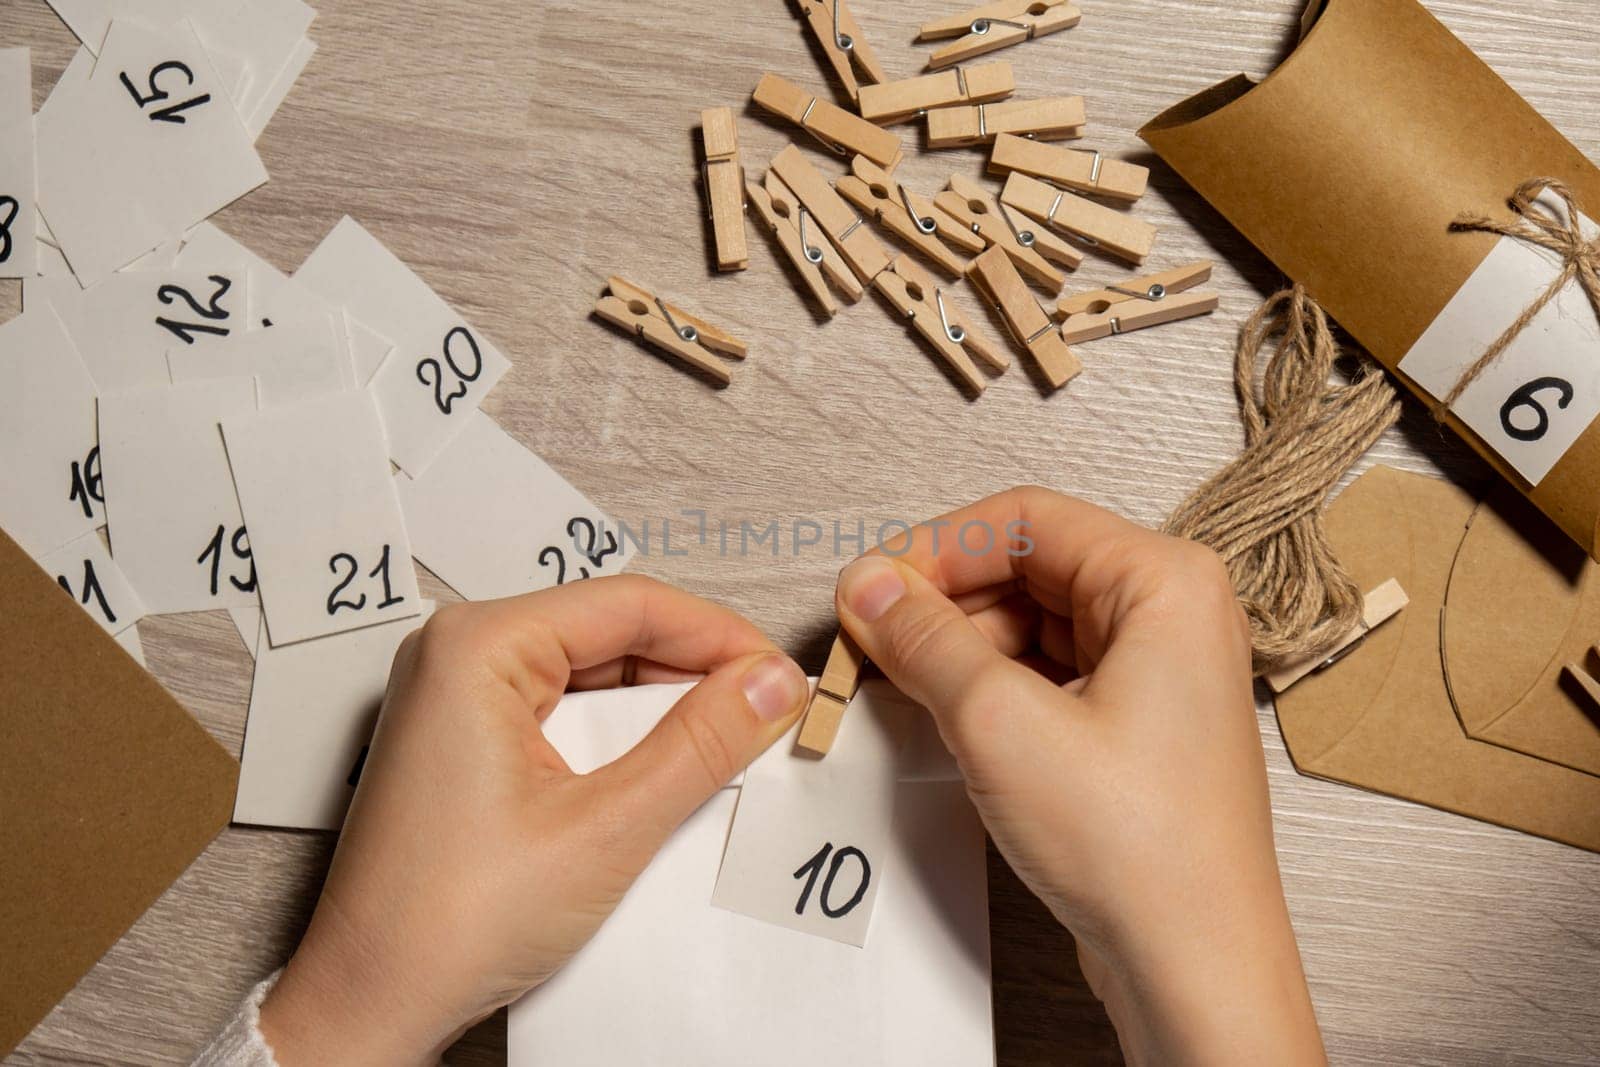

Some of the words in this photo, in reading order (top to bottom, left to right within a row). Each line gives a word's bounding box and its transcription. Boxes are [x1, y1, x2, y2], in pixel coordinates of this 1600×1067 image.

[119, 60, 211, 124] 15
[155, 275, 232, 344] 12
[416, 326, 482, 415] 20
[1500, 376, 1574, 442] 6
[197, 524, 258, 596] 19
[327, 544, 404, 615] 21
[793, 832, 871, 918] 10
